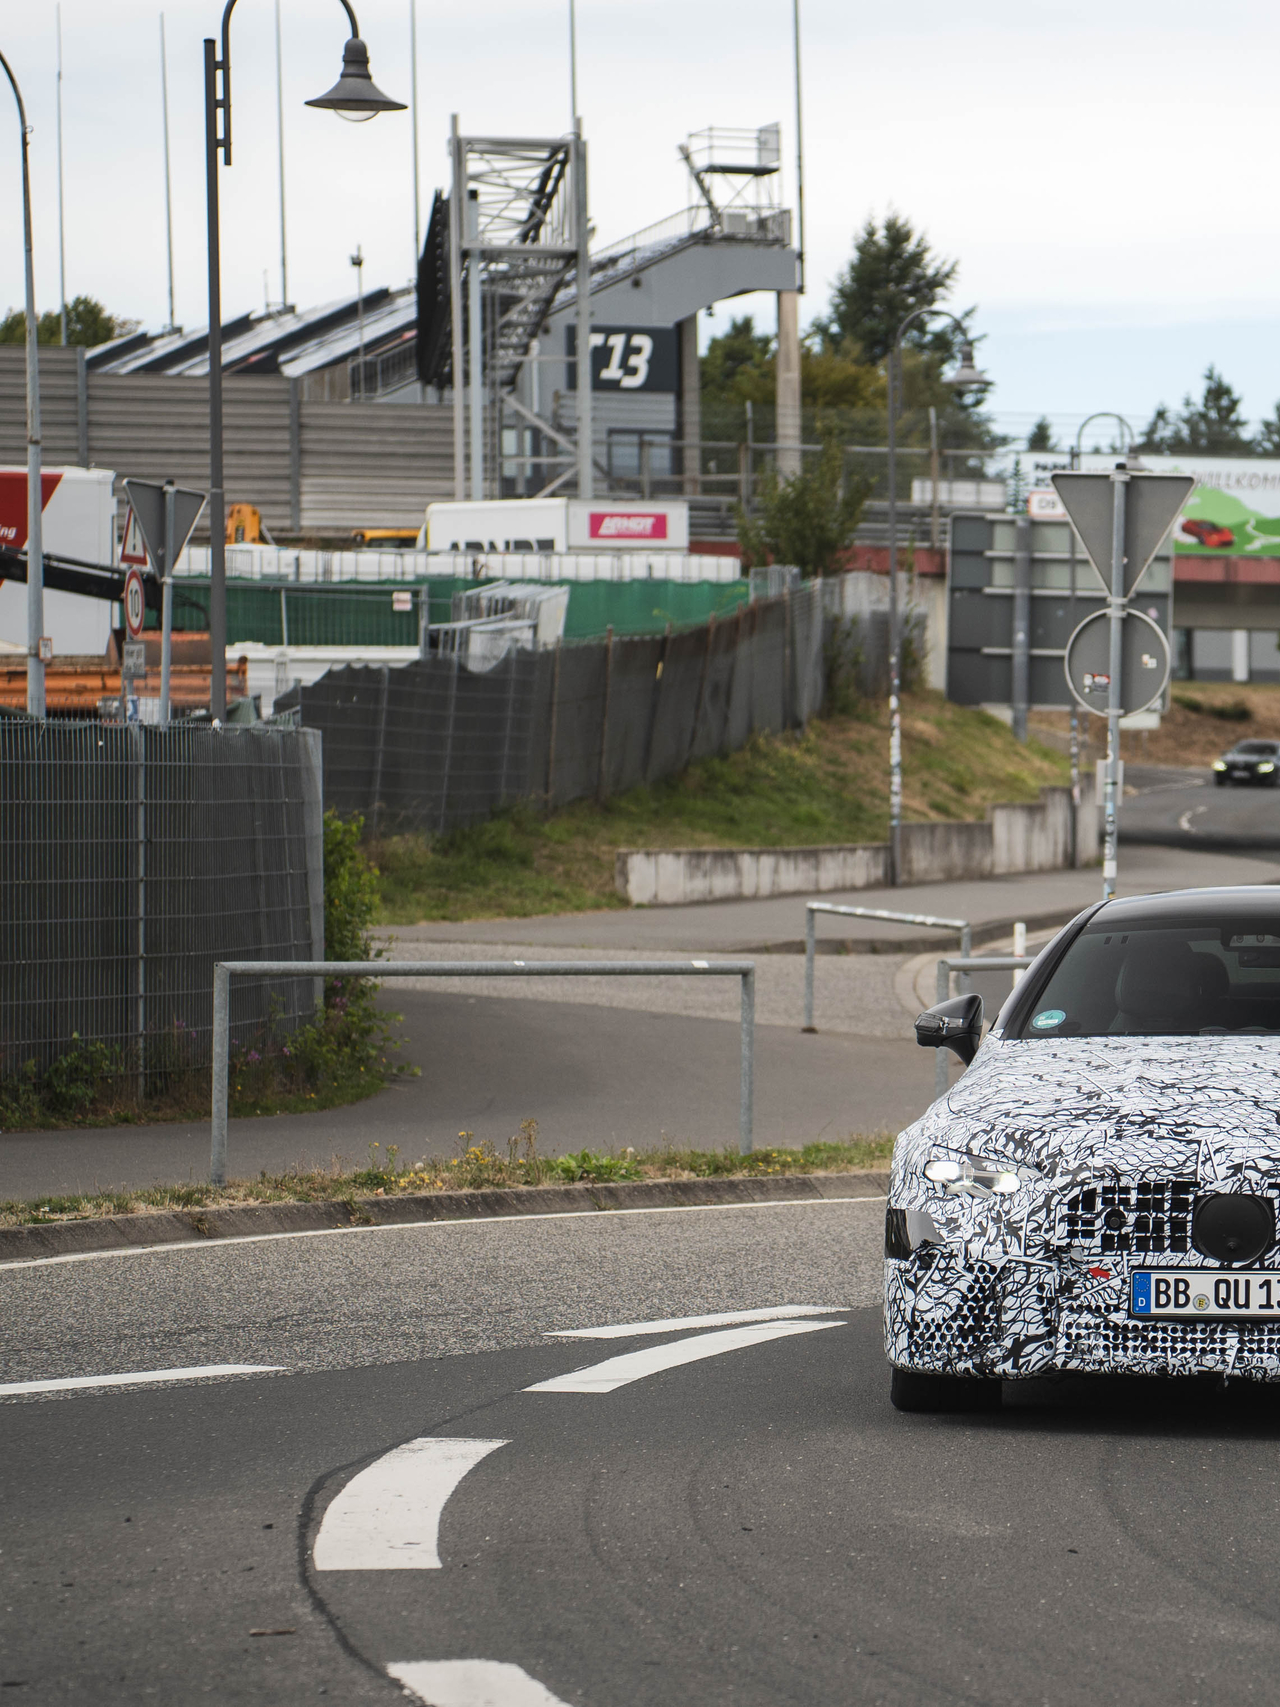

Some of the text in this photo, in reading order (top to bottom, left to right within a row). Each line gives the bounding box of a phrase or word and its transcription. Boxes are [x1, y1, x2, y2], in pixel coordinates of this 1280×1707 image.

[129, 588, 140, 619] 10
[1138, 1297, 1146, 1307] D
[1154, 1278, 1190, 1309] BB
[1214, 1278, 1250, 1309] QU
